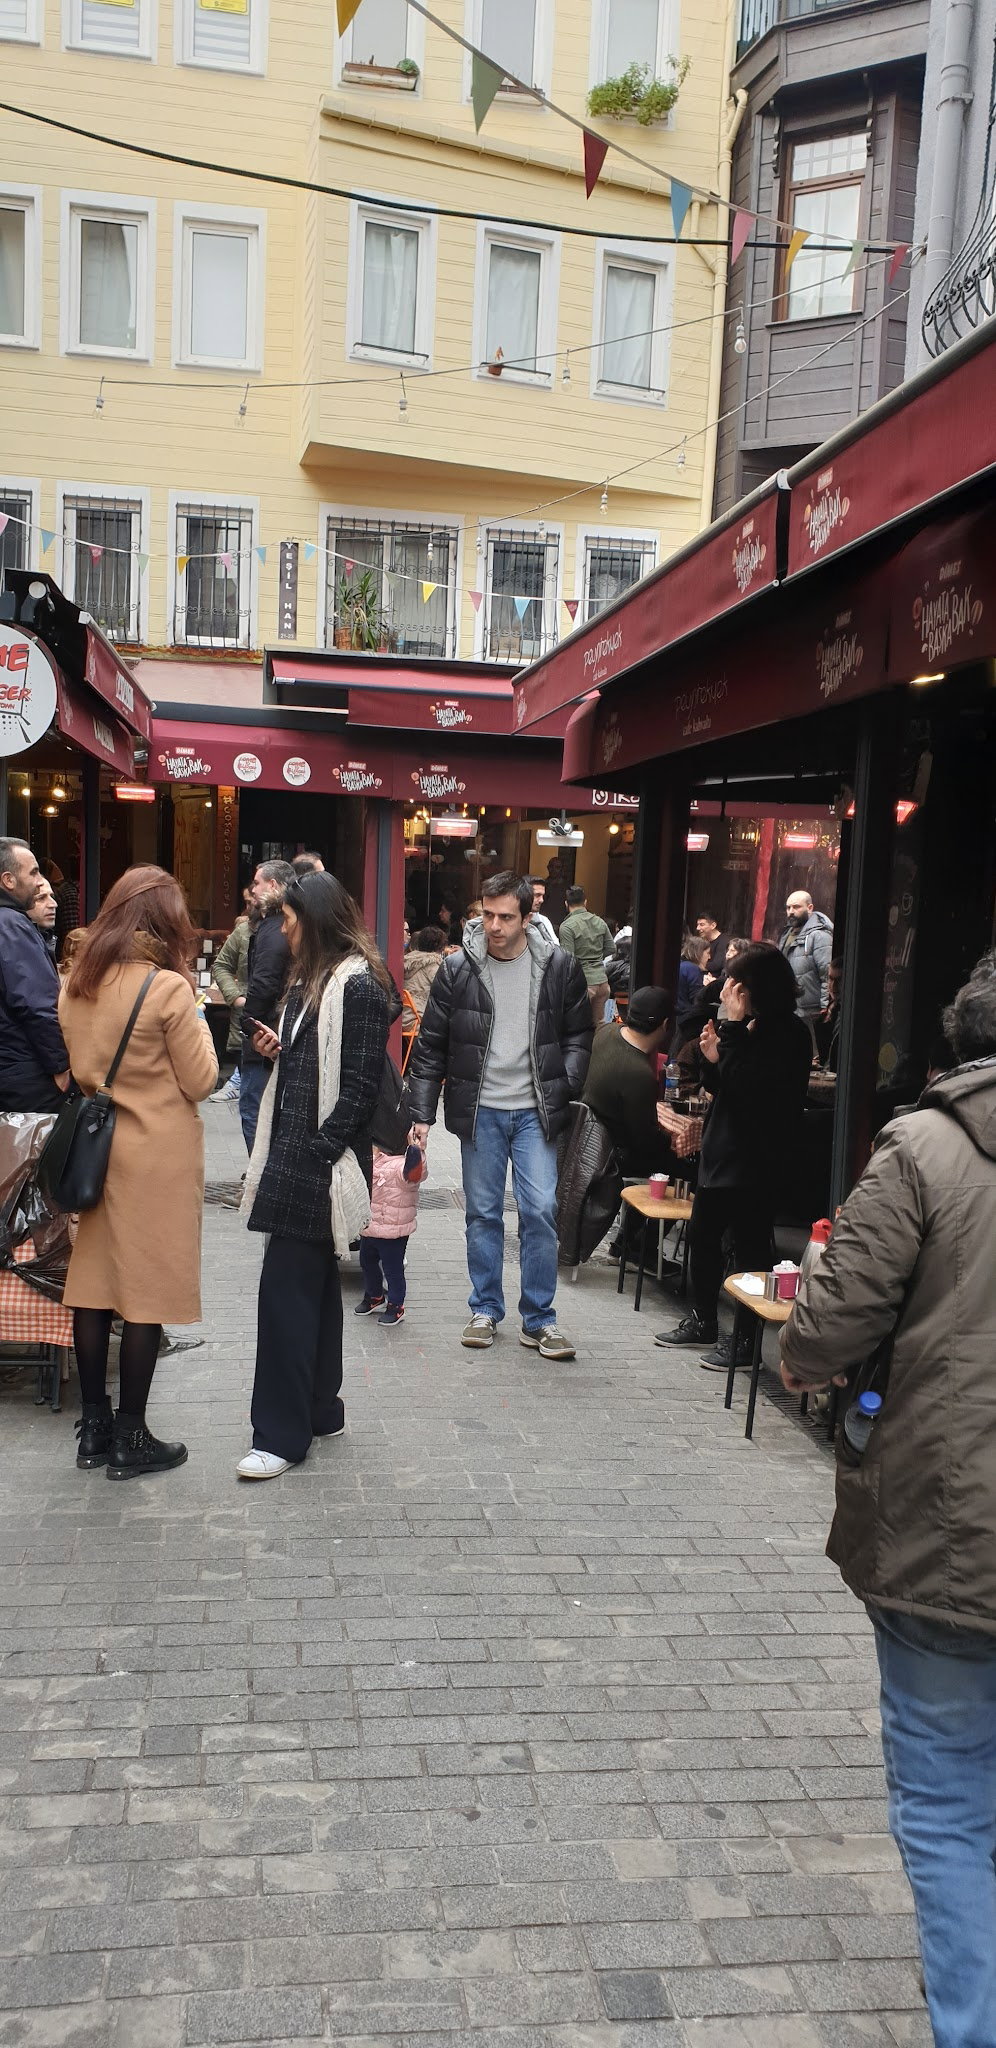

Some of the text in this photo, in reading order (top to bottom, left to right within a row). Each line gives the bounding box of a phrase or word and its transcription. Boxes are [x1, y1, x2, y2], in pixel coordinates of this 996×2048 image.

[284, 602, 292, 629] HAN
[921, 591, 949, 641] HAYATA
[951, 584, 973, 635] BAK
